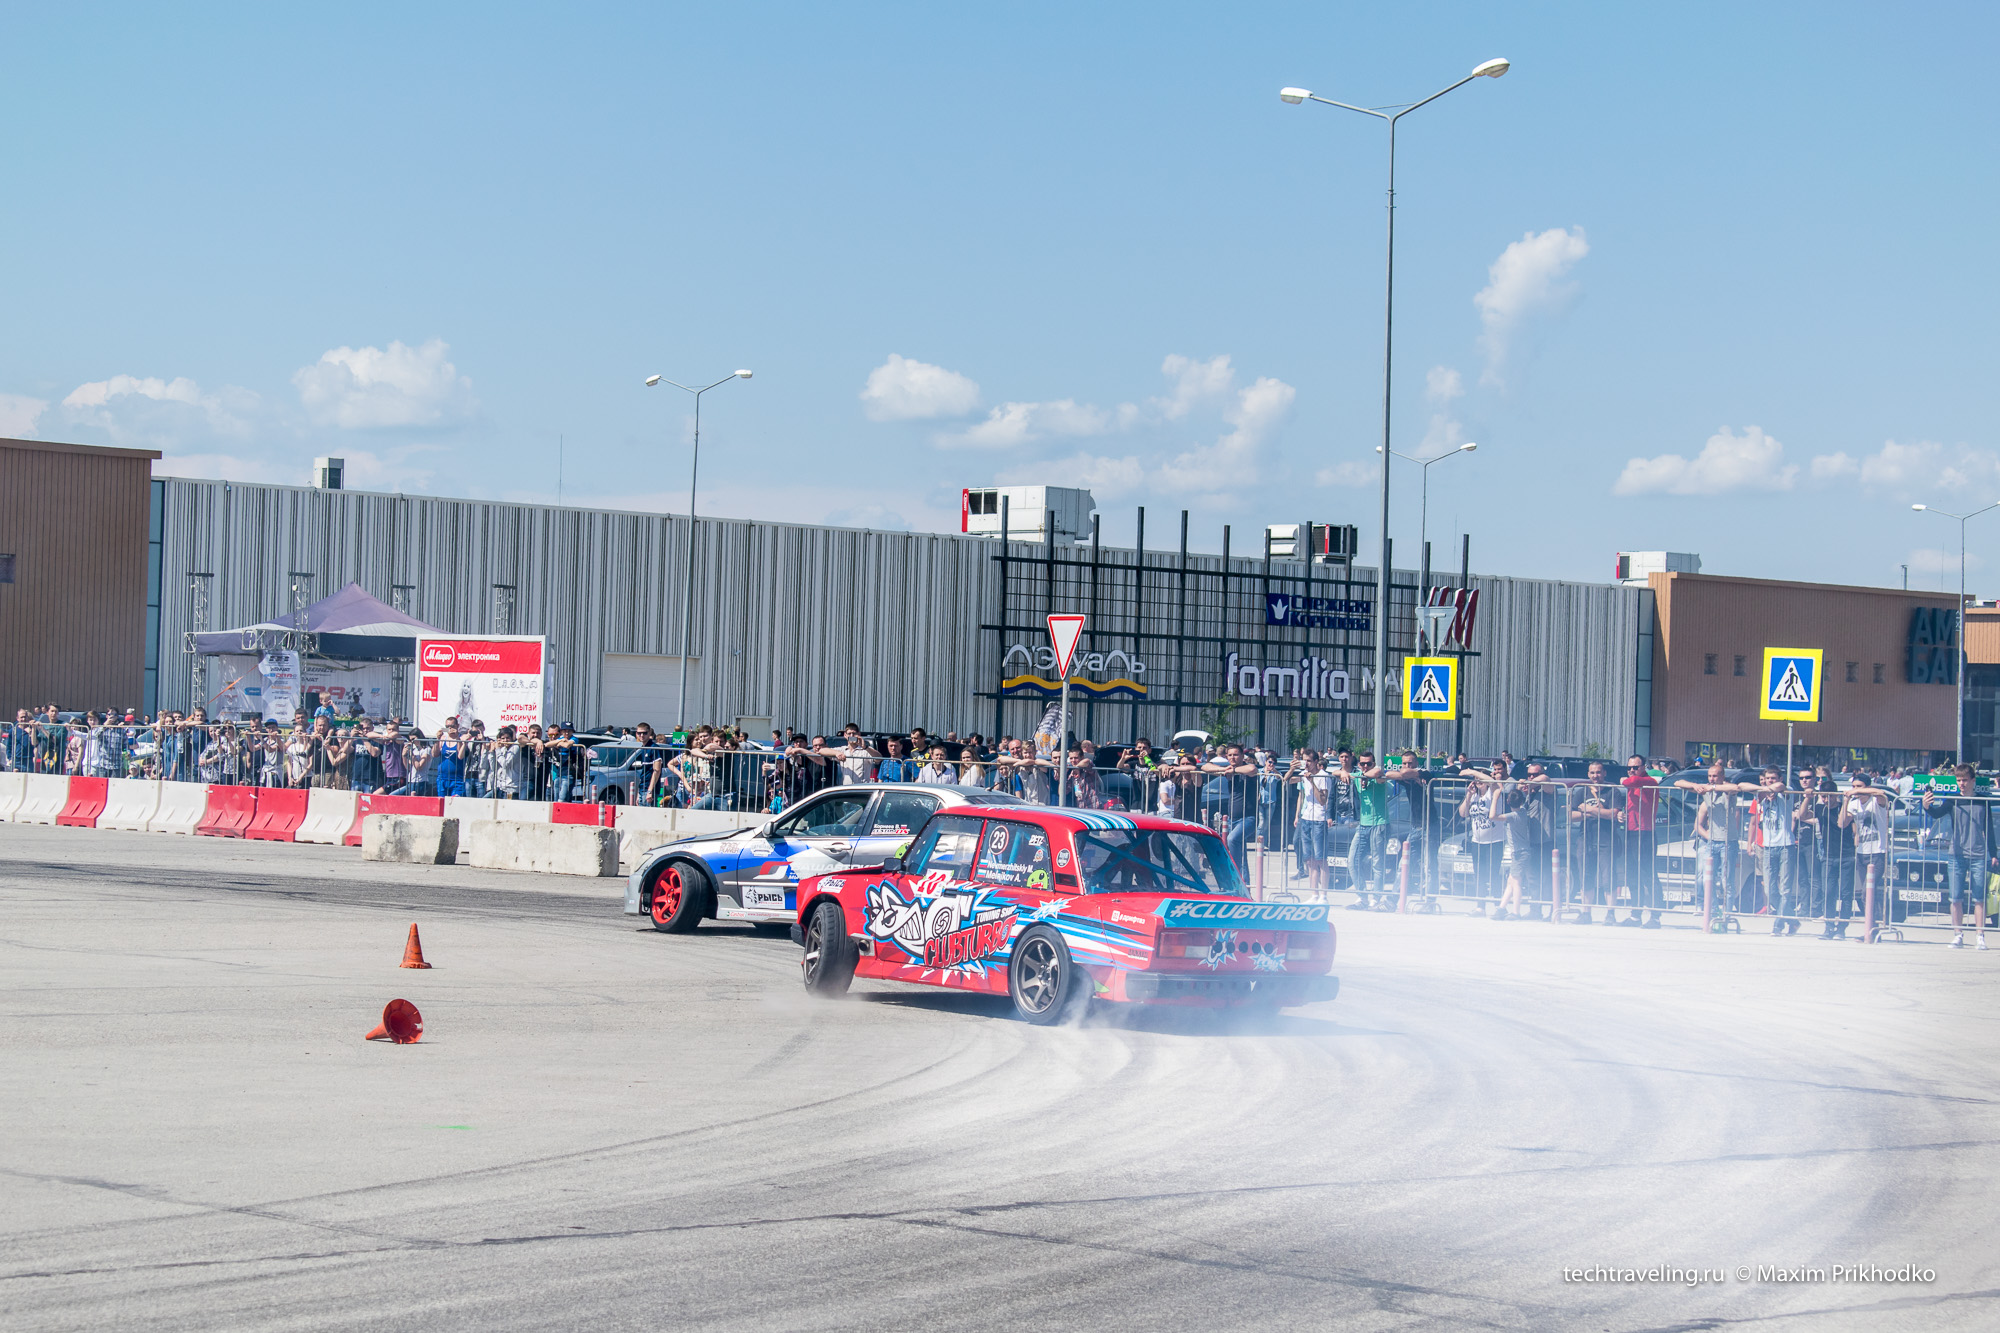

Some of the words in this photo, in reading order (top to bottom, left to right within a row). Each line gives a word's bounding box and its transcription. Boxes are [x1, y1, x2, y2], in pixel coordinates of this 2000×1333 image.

[457, 652, 501, 663] электроника
[1002, 643, 1147, 676] Л'Эуаль
[1226, 651, 1350, 701] familia
[500, 714, 537, 724] максимум
[991, 830, 1006, 850] 23
[1013, 873, 1022, 883] A.
[758, 893, 783, 902] РЫСЬ
[976, 909, 1001, 924] TUNING
[1169, 902, 1326, 922] #CLUBTURBO
[923, 913, 1020, 968] CLUBTURBO
